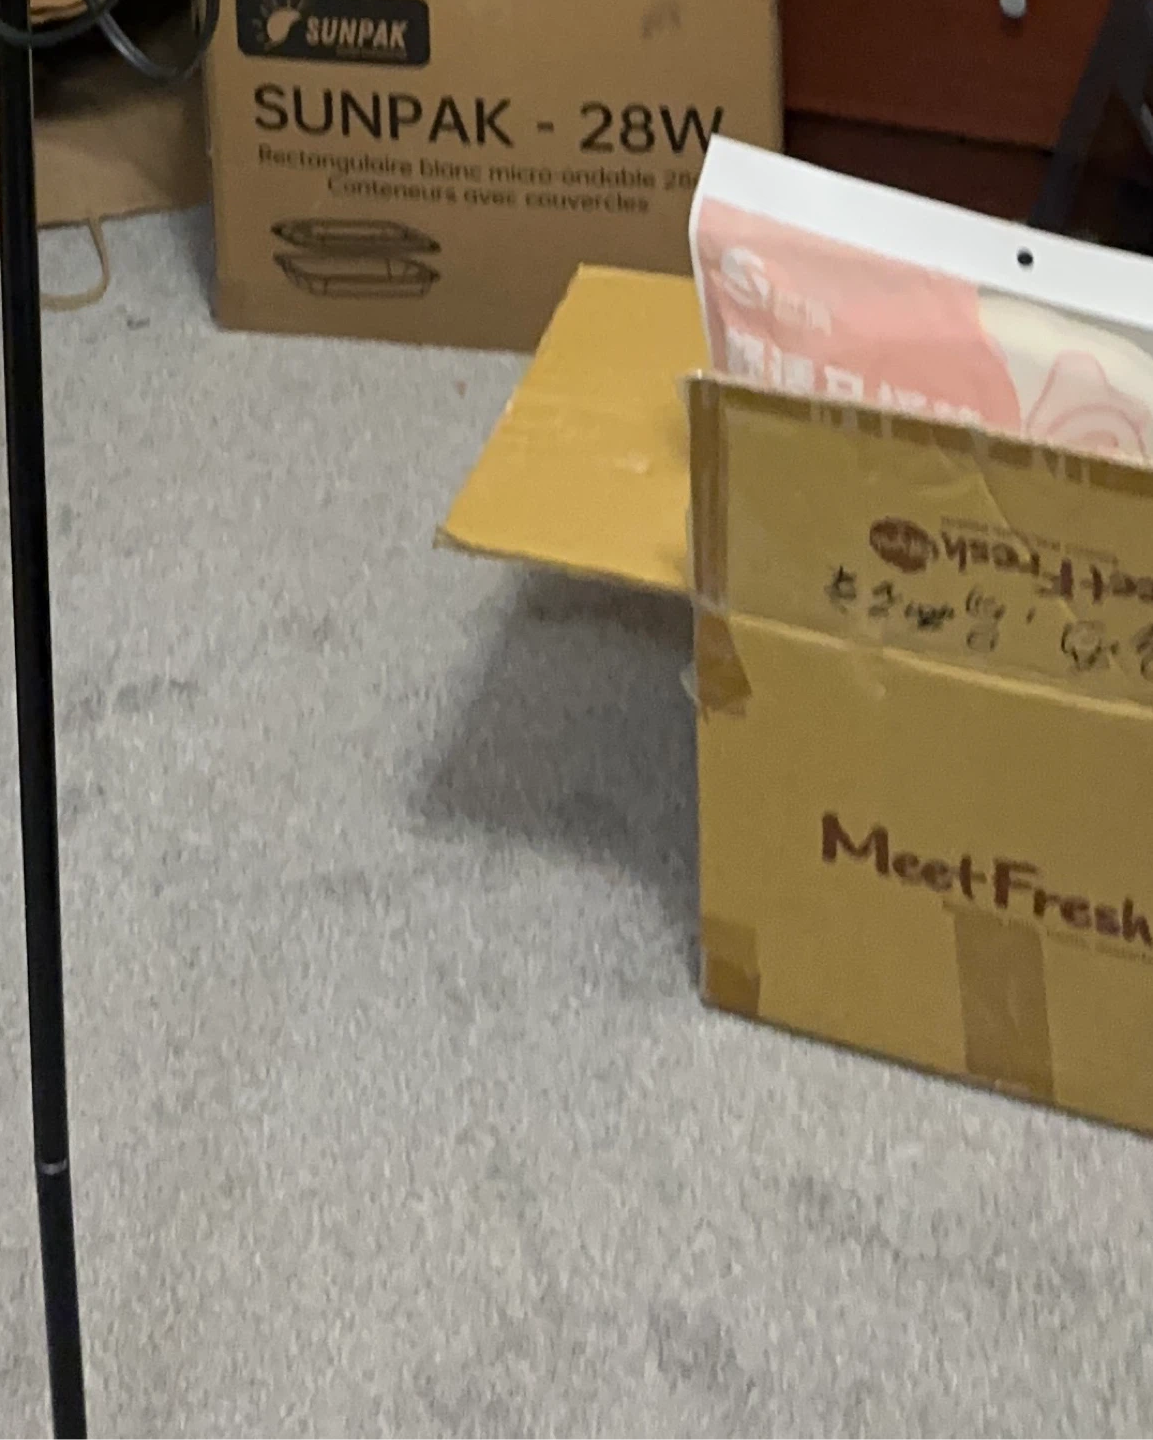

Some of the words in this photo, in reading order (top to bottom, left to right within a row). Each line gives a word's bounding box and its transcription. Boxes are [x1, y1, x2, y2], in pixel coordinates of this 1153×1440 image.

[306, 15, 409, 48] SUNPAK
[253, 81, 515, 149] SUNPAK
[580, 99, 725, 155] 28W
[258, 141, 413, 177] Rectangulaire
[328, 176, 458, 204] Conteneurs
[463, 187, 517, 207] avec
[524, 192, 650, 214] couvercles
